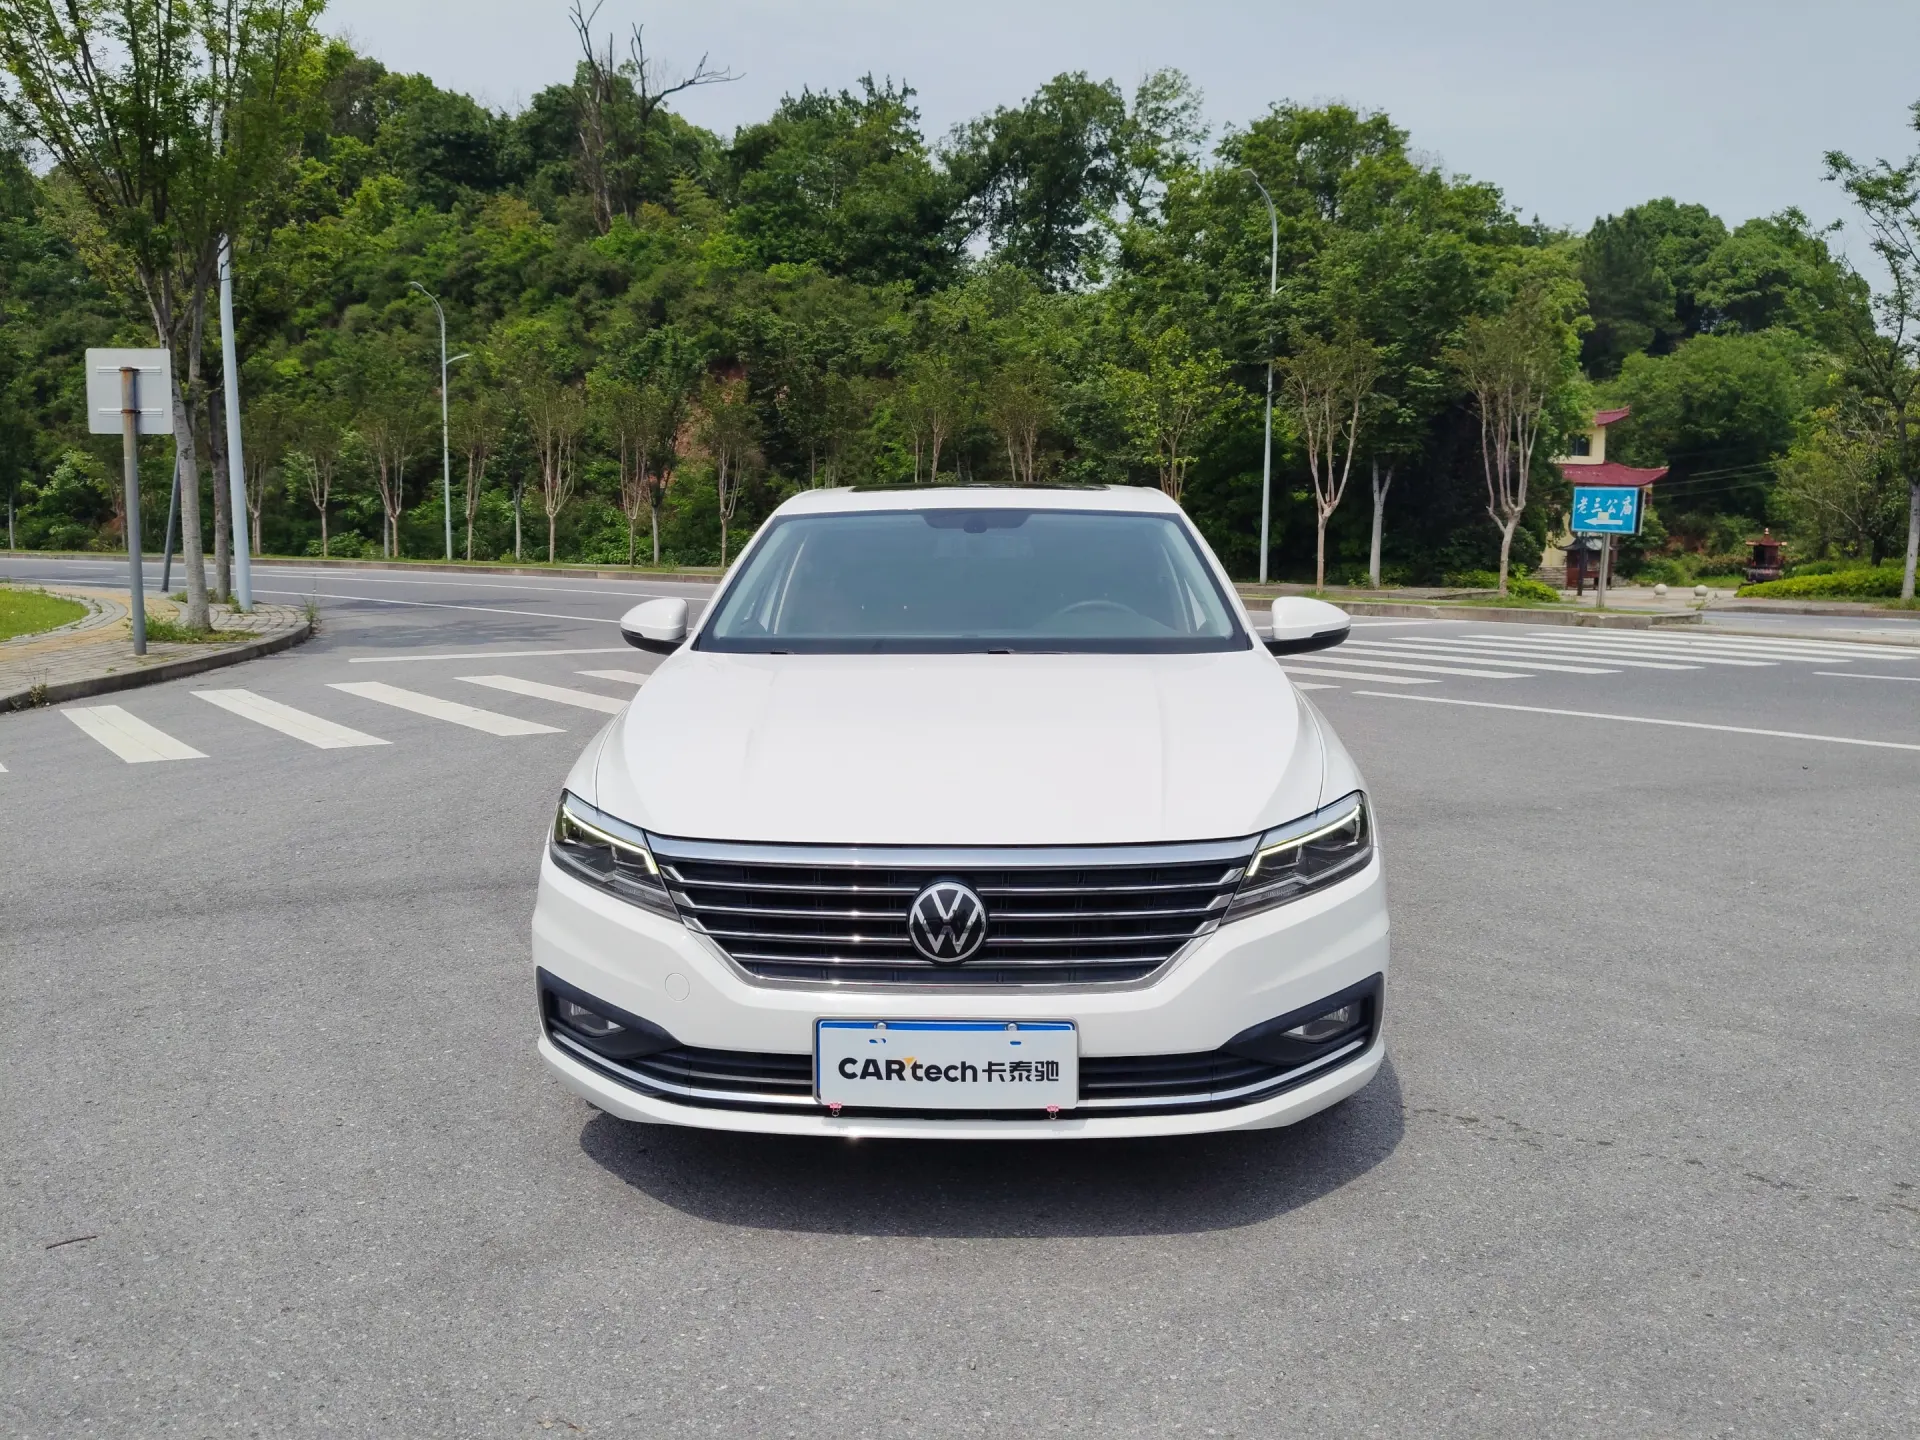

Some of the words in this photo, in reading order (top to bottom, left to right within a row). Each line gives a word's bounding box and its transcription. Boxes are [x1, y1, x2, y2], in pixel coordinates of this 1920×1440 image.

[911, 884, 984, 958] VW
[838, 1057, 978, 1082] CARtech
[982, 1060, 1060, 1082] 卡泰驰
